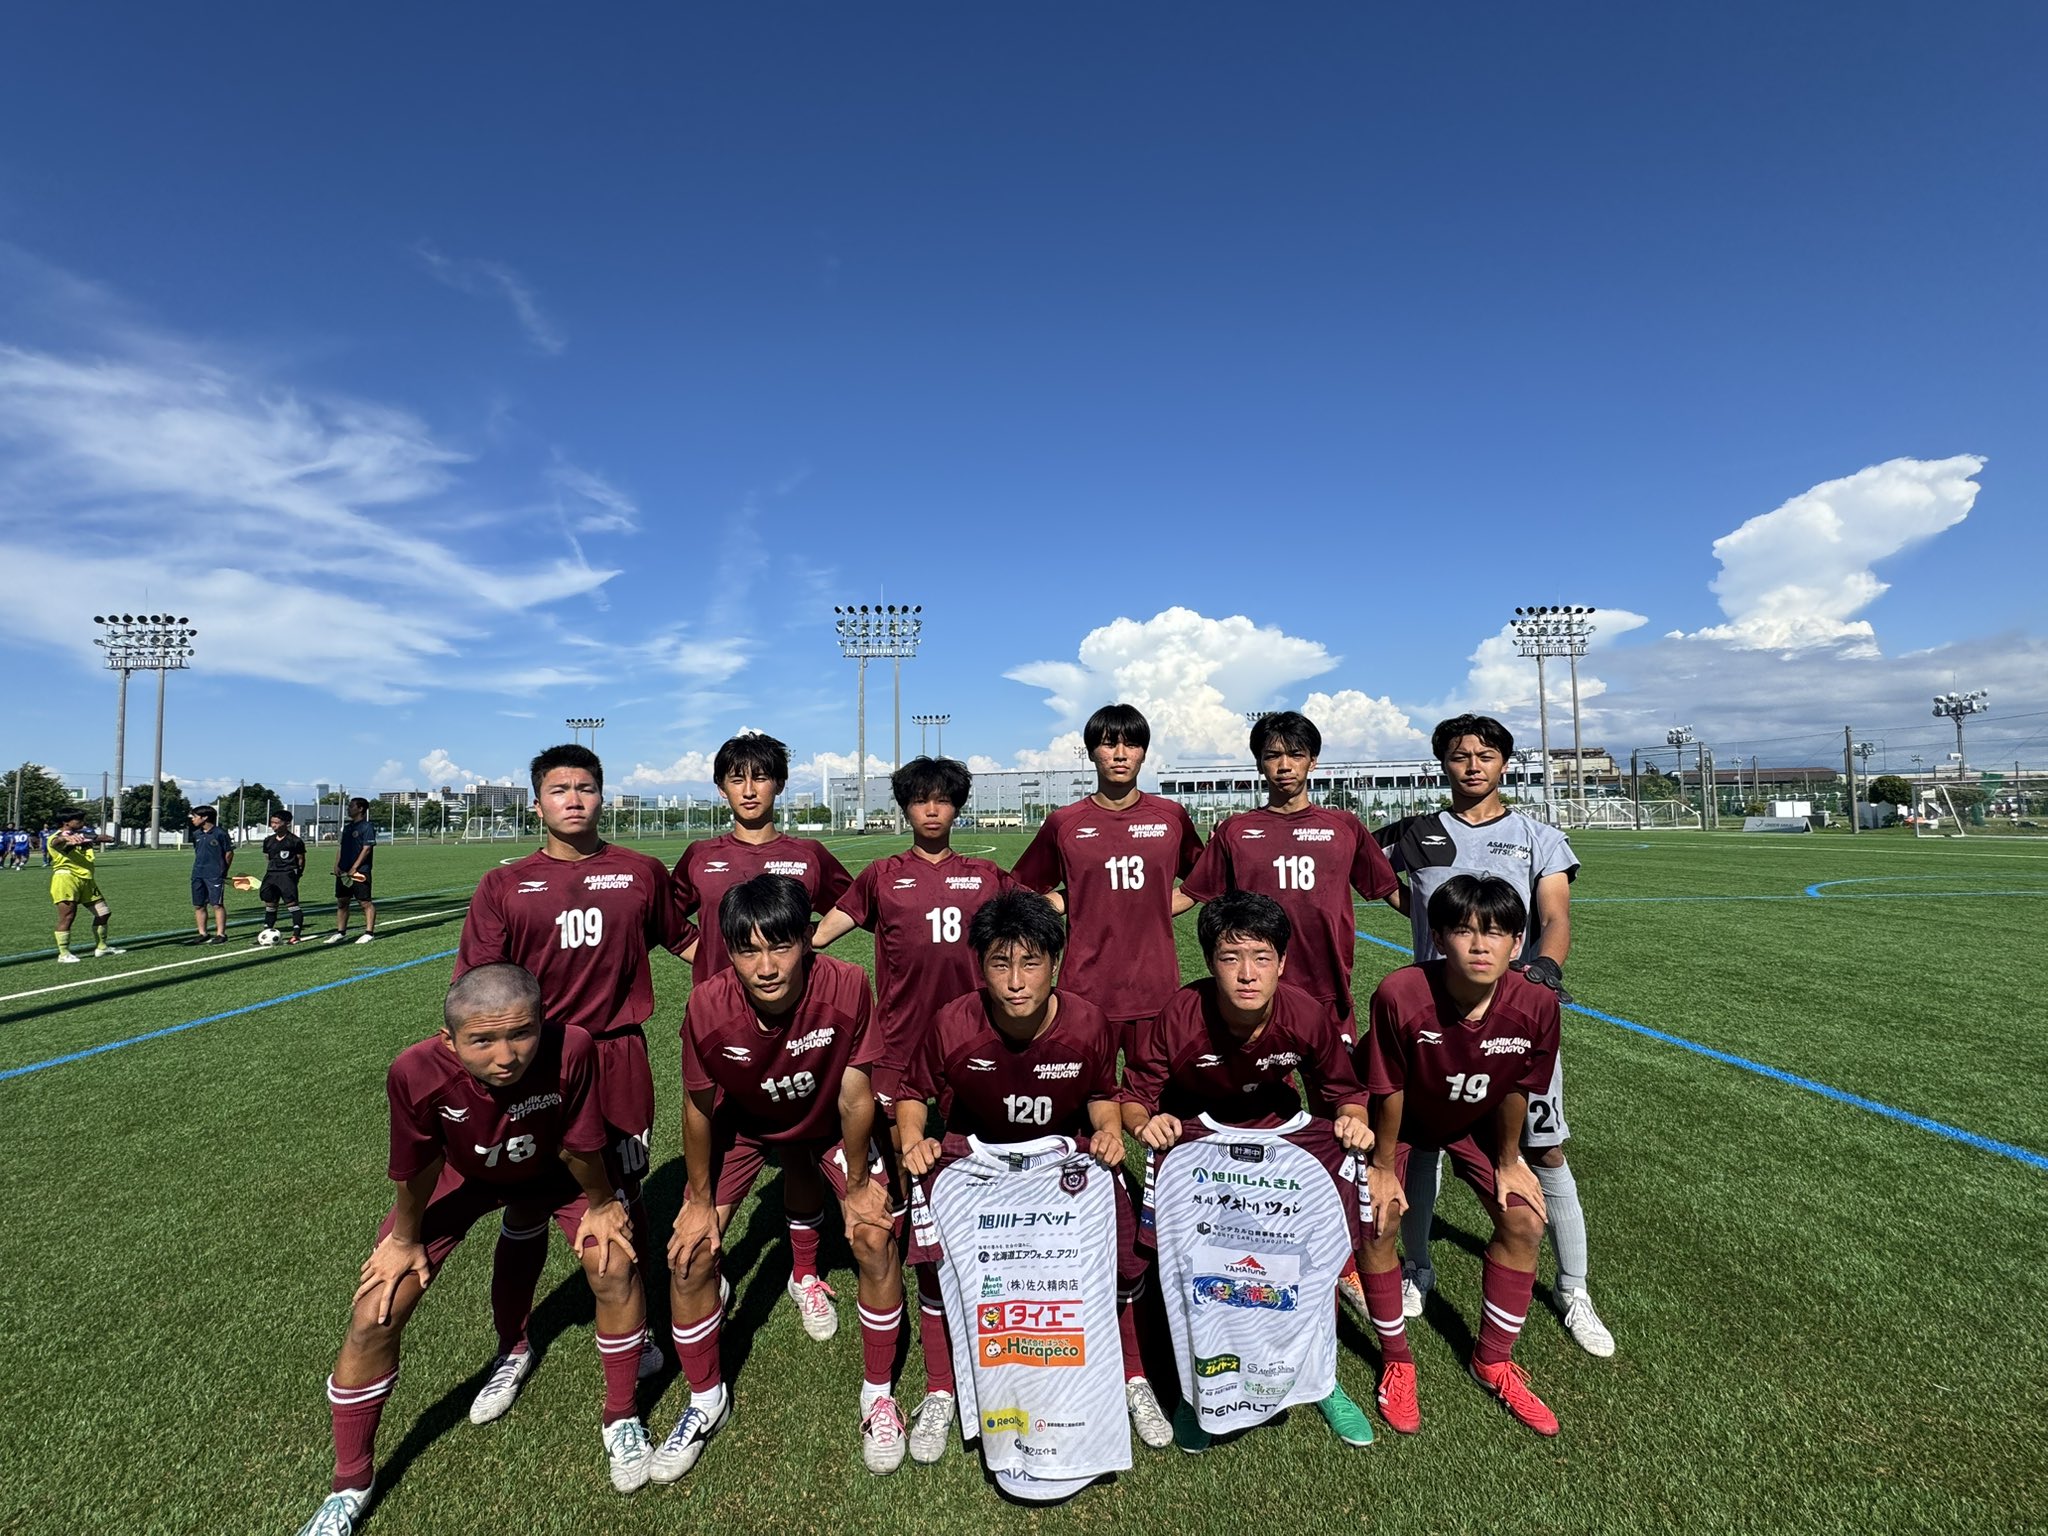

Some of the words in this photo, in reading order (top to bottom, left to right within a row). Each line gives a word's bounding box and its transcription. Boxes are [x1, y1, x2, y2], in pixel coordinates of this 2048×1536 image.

[1128, 824, 1167, 832] ASAHIKAWA
[1132, 830, 1165, 838] JITSUGYO
[1292, 828, 1335, 836] ASAHIKAWA
[1489, 848, 1529, 860] JITSUO
[763, 861, 808, 870] ASAHIKAWA
[1104, 855, 1145, 890] 113
[1272, 855, 1315, 891] 118
[583, 874, 634, 884] ASAHIKAWA
[588, 881, 629, 890] JITSUGYO
[555, 907, 603, 949] 109
[925, 906, 962, 943] 18
[786, 1027, 835, 1050] ASAHIKAWA
[791, 1037, 832, 1057] JITSUGYO
[1033, 1062, 1083, 1072] ASAHIKAW
[1255, 1051, 1302, 1066] ASHIKAWA
[1037, 1070, 1080, 1079] JITSUGYO
[760, 1071, 816, 1102] 119
[1446, 1073, 1490, 1103] 19
[1003, 1094, 1052, 1125] 120
[1212, 1171, 1302, 1191] 旭川しんきん
[978, 1211, 1077, 1230] 旭川トヨペット
[1007, 1337, 1079, 1365] Harapeco
